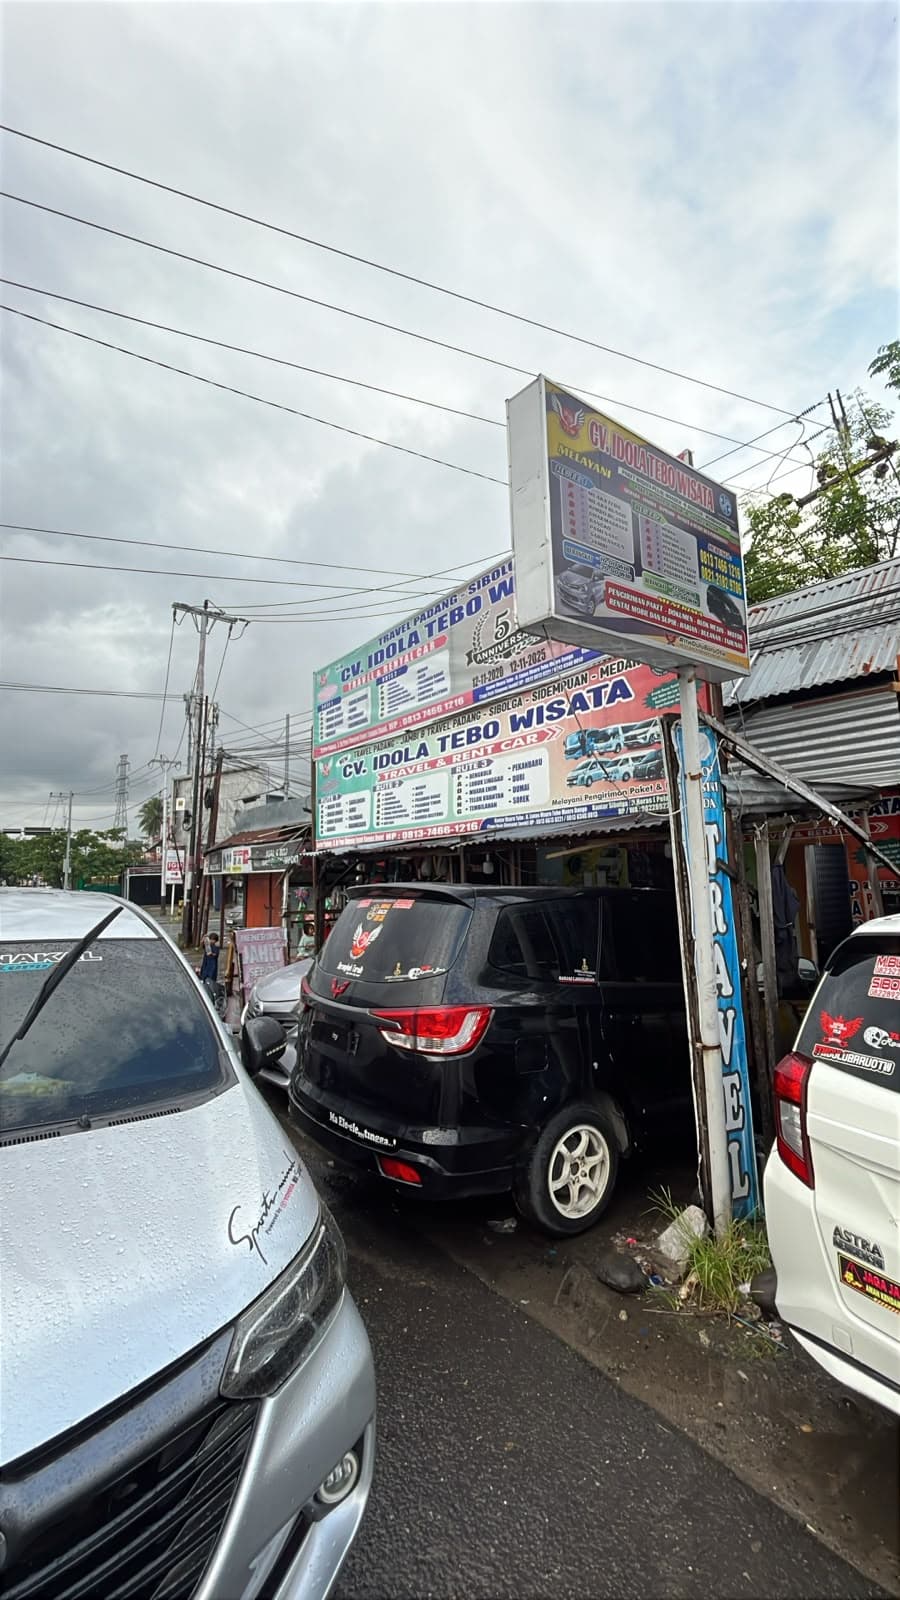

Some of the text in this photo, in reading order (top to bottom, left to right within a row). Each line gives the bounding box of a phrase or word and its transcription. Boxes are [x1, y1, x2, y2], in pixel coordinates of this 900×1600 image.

[557, 443, 612, 478] MELAYANI
[611, 432, 648, 476] IDOLA
[647, 451, 676, 491] TEBO
[675, 469, 715, 513] WISATA
[341, 661, 364, 683] CV.
[368, 630, 420, 669] IDOLA
[424, 595, 482, 638] TEBO
[378, 618, 412, 646] TRAVEL
[413, 594, 458, 627] PADANG
[493, 608, 510, 642] 5
[383, 654, 414, 673] RENTAL
[416, 641, 435, 658] CAR
[472, 667, 504, 688] 12-11-2020
[510, 648, 546, 673] 12-11-2025
[342, 761, 367, 778] CV.
[373, 742, 429, 771] IDOLA
[437, 720, 500, 753] TEBO
[509, 678, 633, 733] WISATA
[354, 747, 372, 759] TRAVEL
[373, 740, 395, 753] PADANG
[427, 723, 451, 737] TRAVEL
[452, 711, 481, 729] PADANG
[489, 697, 523, 718] SIBOLGA
[532, 674, 588, 701] SIDEMPUAN
[384, 733, 539, 780] TRAVEL & RENT CAR
[552, 795, 583, 806] Melayani
[584, 790, 628, 802] Pengiriman
[629, 785, 653, 795] Paket
[833, 1225, 884, 1259] ASTRA
